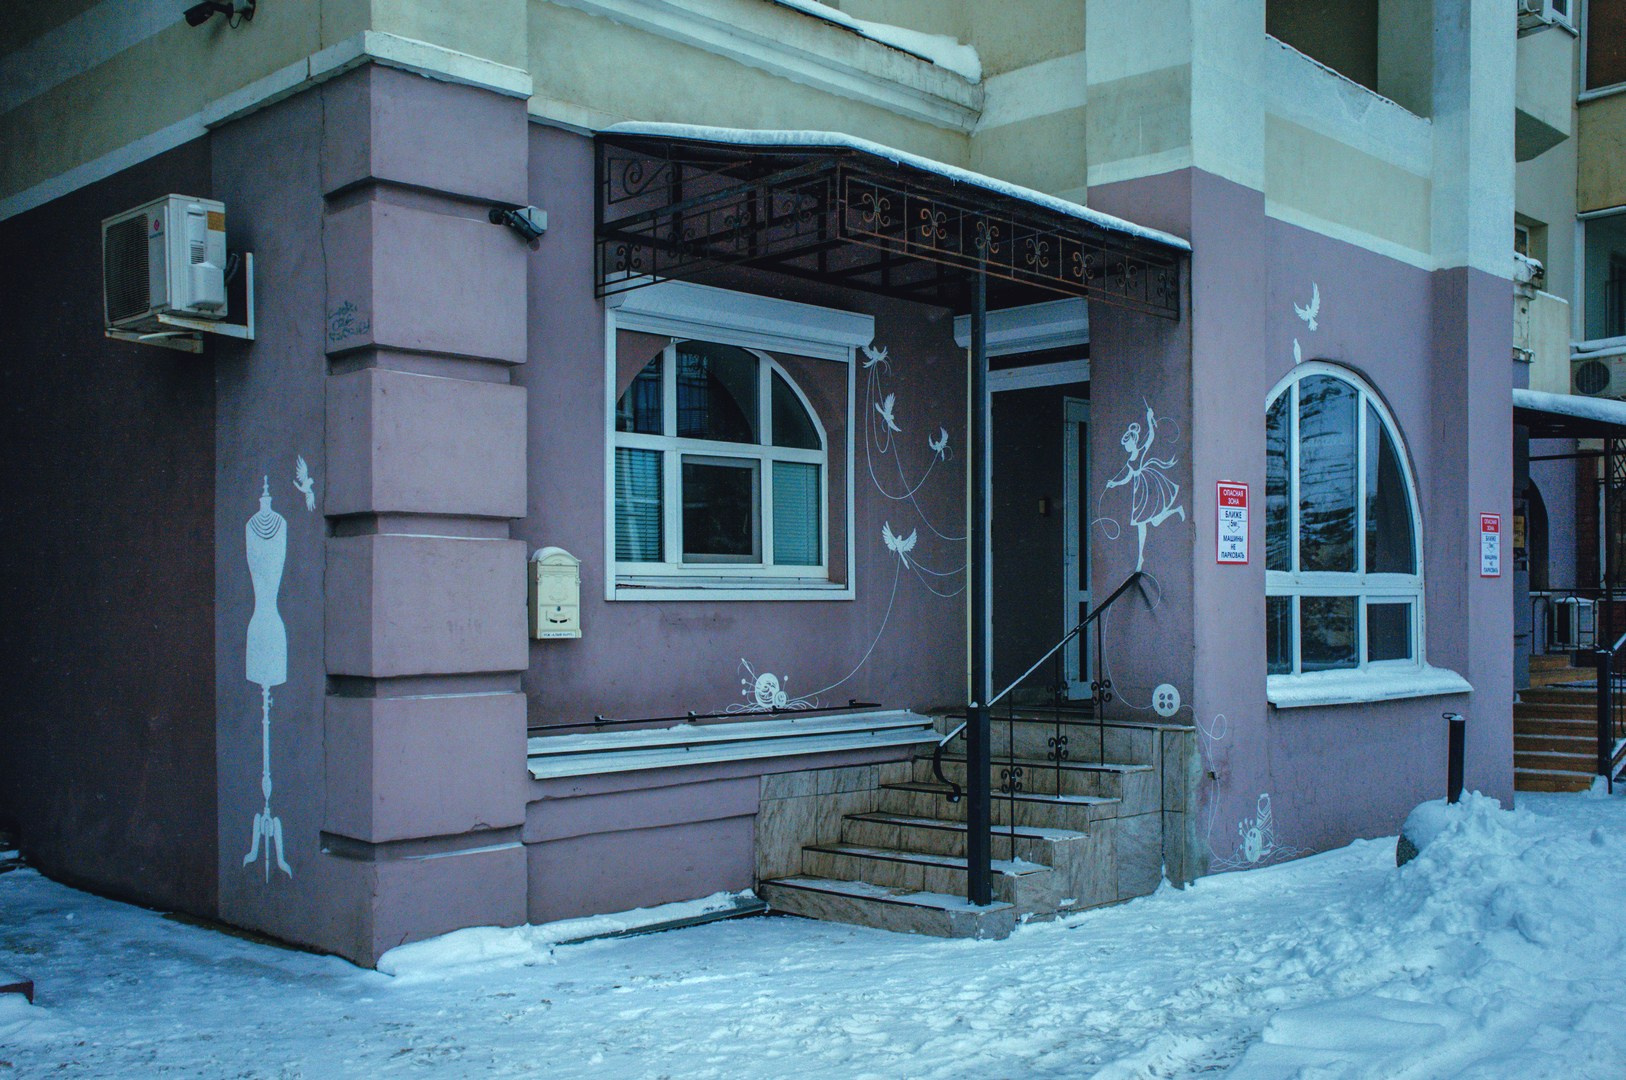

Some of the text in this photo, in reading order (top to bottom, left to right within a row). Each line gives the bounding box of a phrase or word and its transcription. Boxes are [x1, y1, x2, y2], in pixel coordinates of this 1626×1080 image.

[1222, 489, 1244, 497] ОПАСНАЯ
[1227, 497, 1240, 505] ЗОНА
[1225, 510, 1242, 519] БЛИЖЕ
[1221, 551, 1245, 559] ПАРКОВАТЬ
